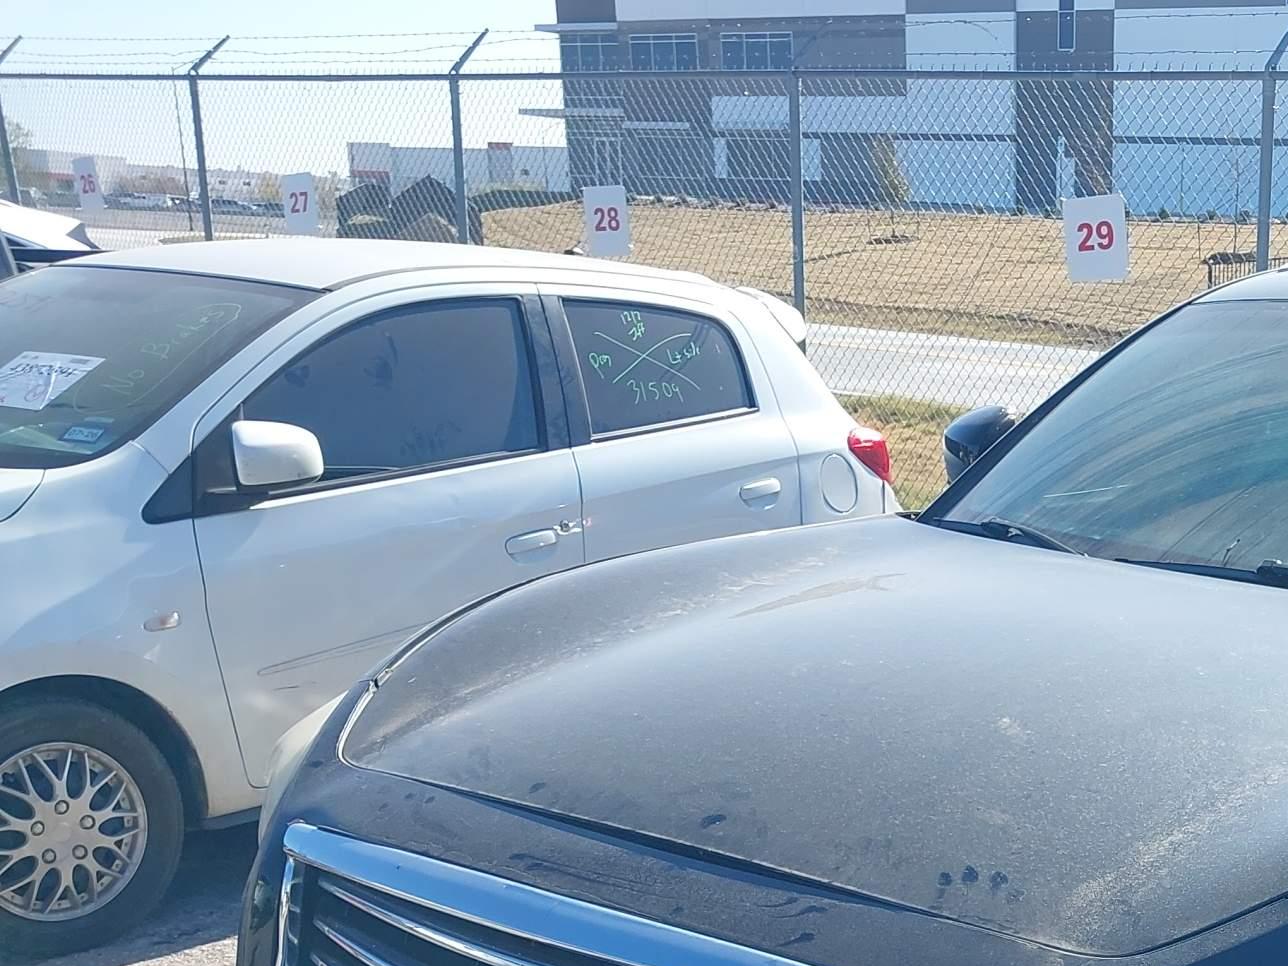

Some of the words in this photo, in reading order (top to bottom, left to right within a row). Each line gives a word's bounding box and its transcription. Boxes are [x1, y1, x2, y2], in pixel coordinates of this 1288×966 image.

[80, 174, 96, 194] 26
[289, 191, 308, 213] 27
[593, 207, 620, 232] 28
[1076, 220, 1113, 252] 29
